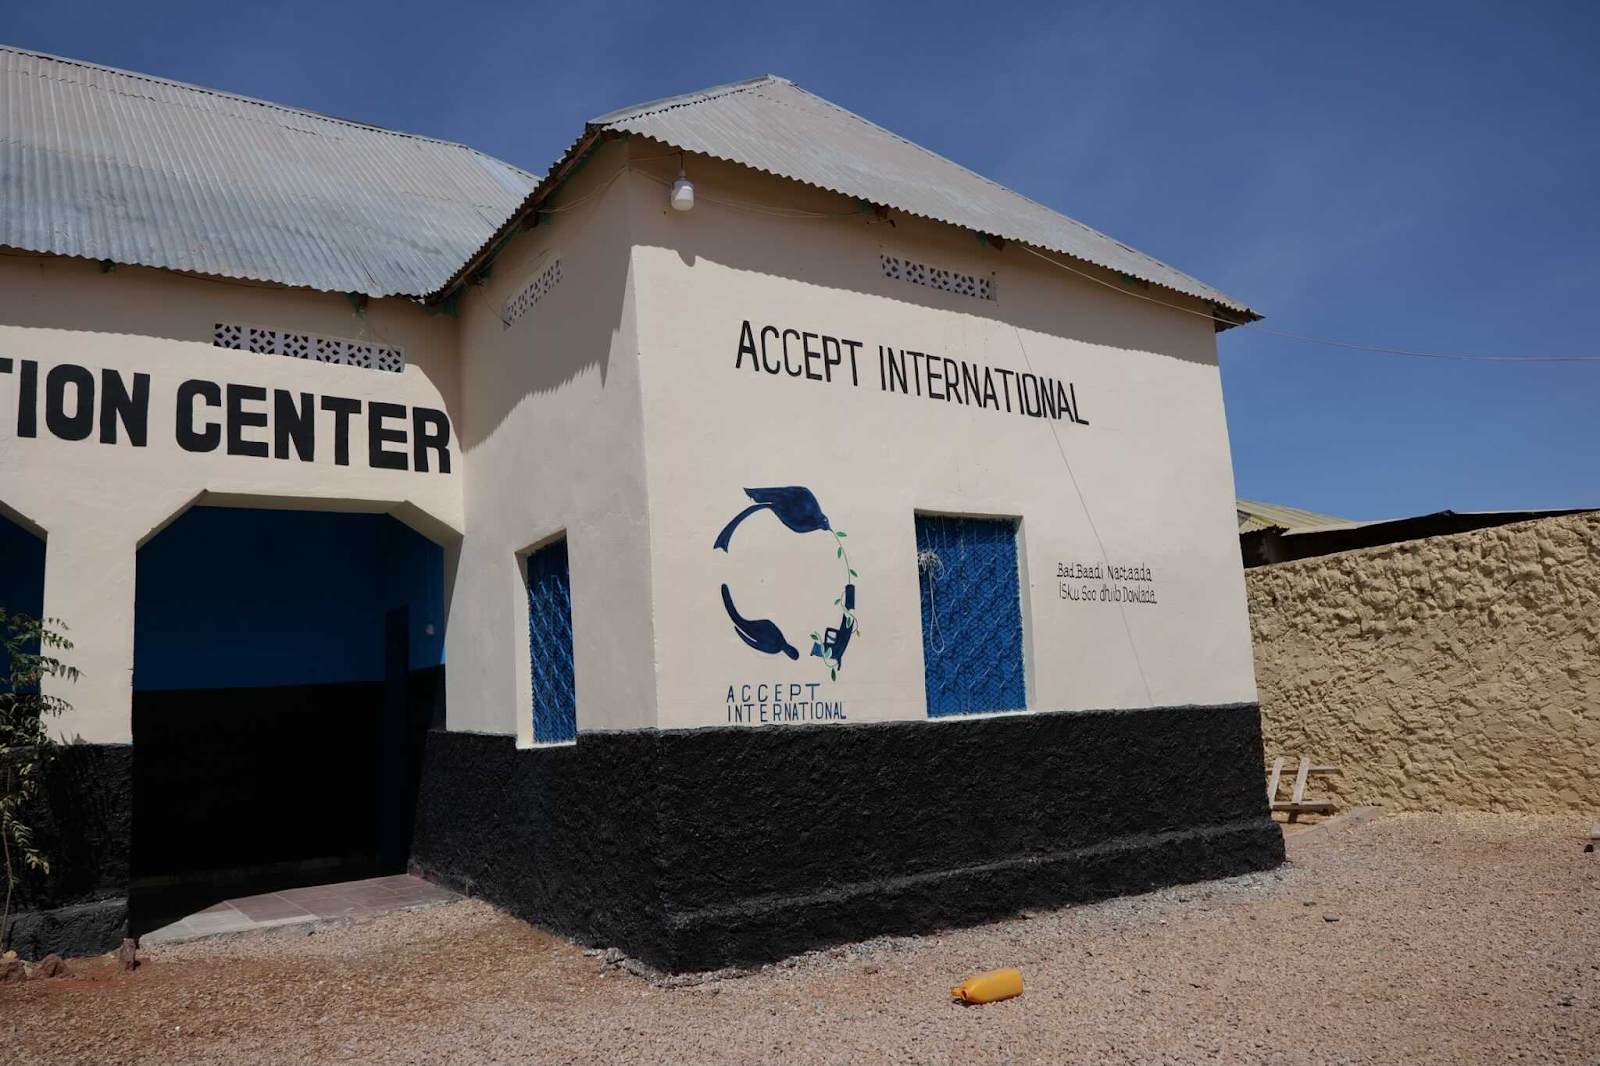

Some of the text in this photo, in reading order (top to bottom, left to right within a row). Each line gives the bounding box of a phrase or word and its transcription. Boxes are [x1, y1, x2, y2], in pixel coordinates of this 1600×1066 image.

[735, 320, 1090, 426] ACCEPT INTERNATIONAL
[175, 378, 451, 474] CENTER
[726, 683, 820, 703] ACCEPT
[727, 701, 847, 723] INTERNATIONAL
